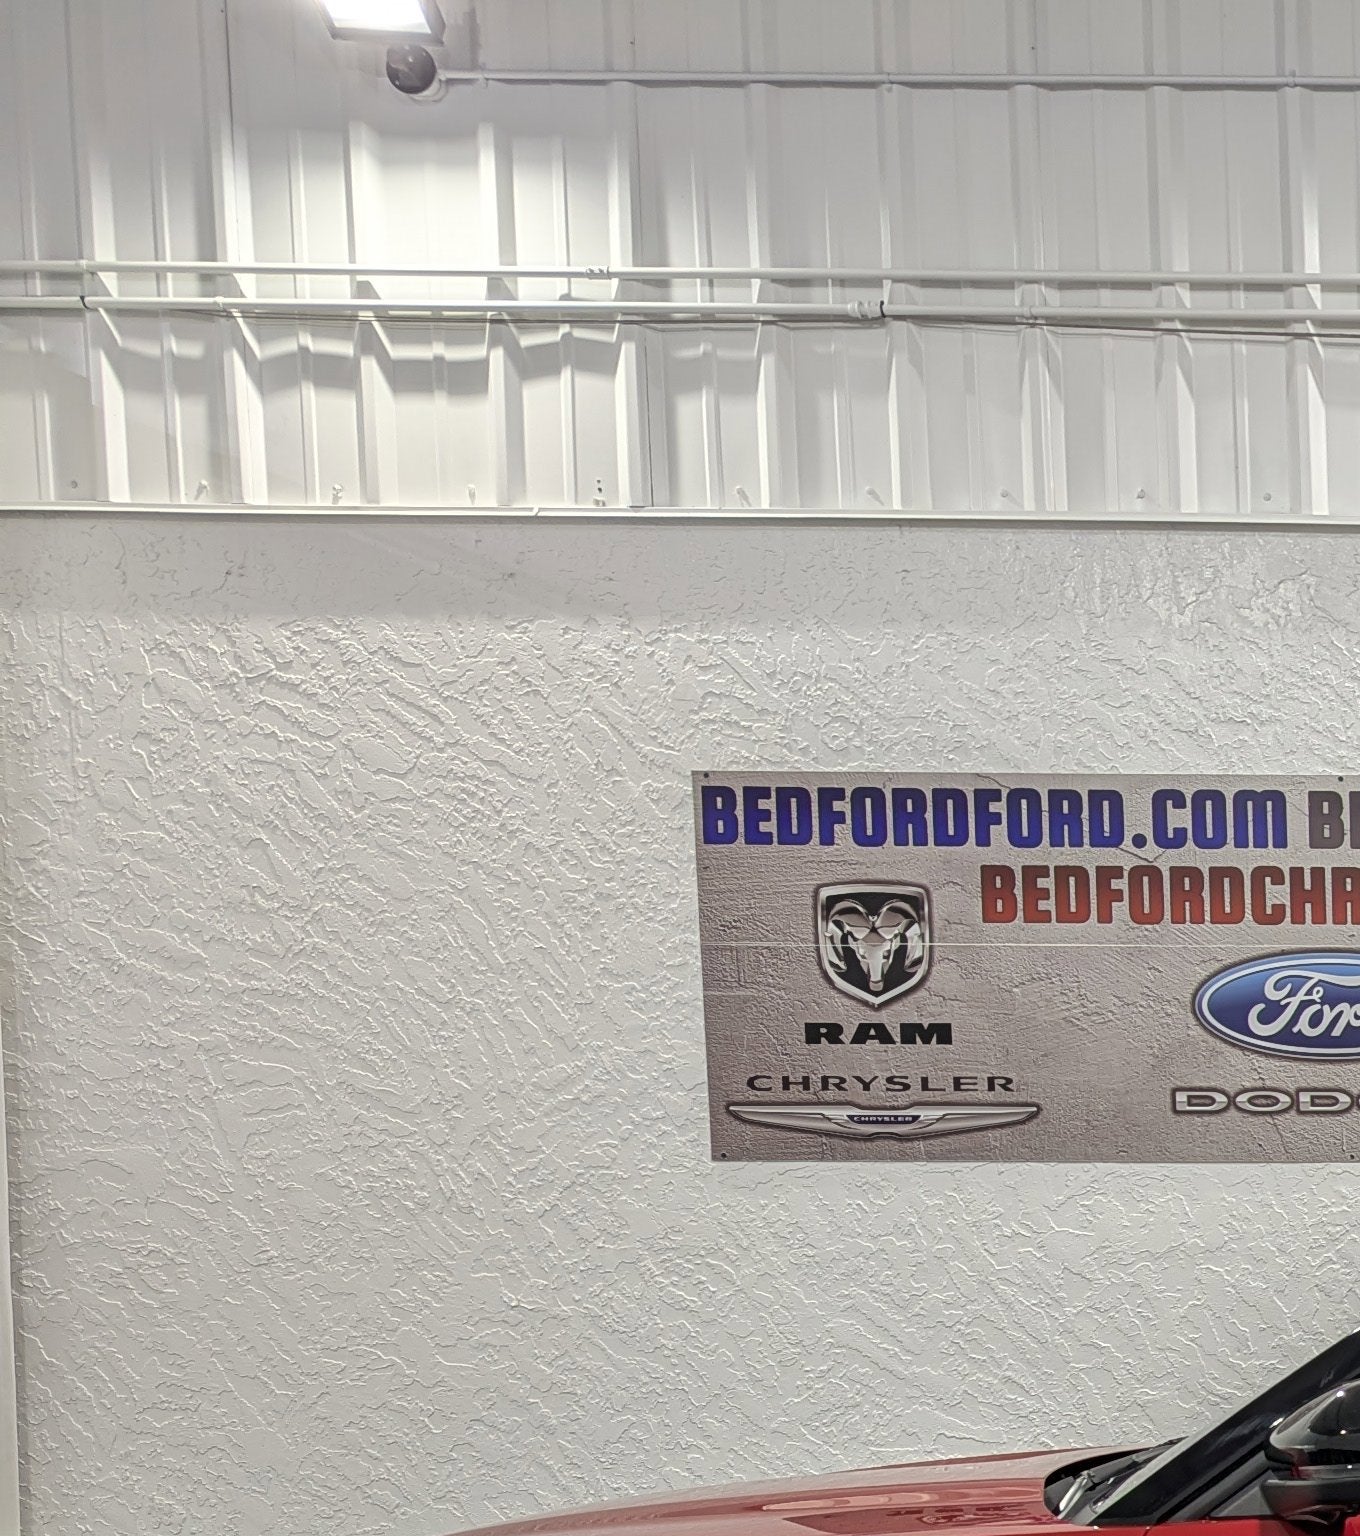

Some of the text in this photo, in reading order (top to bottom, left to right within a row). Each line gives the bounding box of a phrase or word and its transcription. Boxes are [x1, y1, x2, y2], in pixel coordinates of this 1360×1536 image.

[701, 785, 1288, 850] BEDFORDFORD.COM
[804, 1022, 954, 1046] RAM
[746, 1074, 1016, 1093] CHRYSLER
